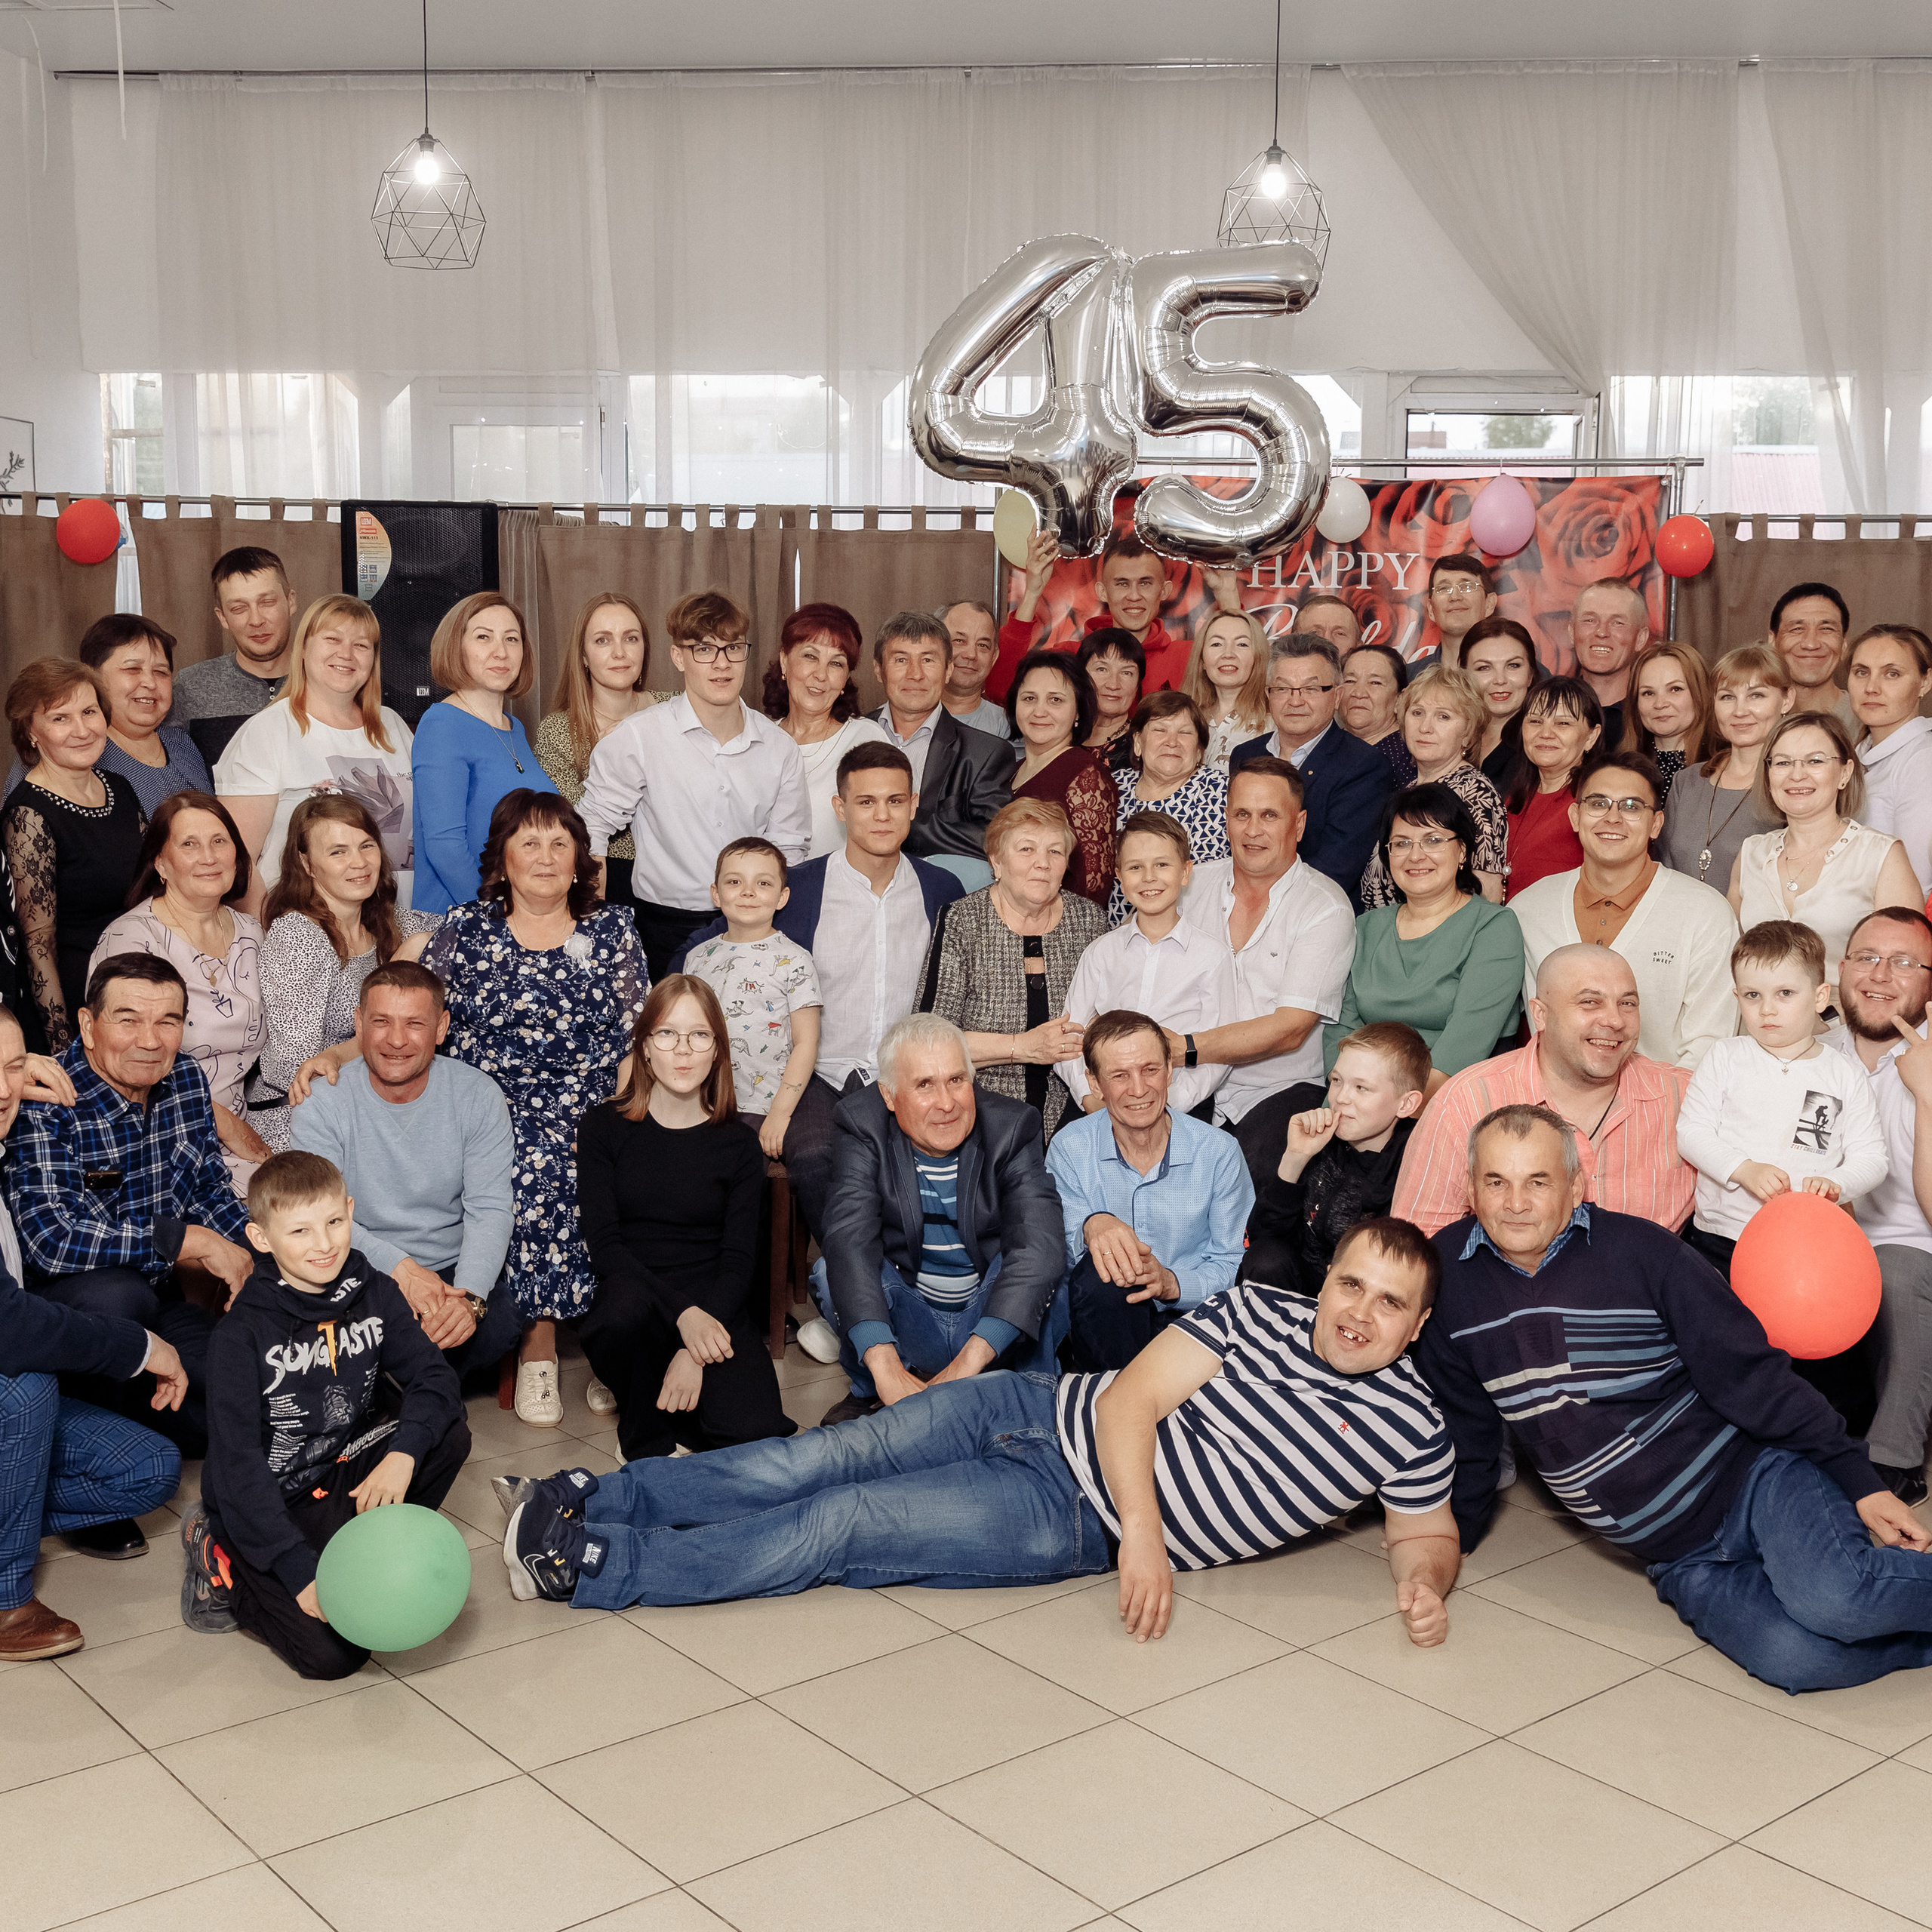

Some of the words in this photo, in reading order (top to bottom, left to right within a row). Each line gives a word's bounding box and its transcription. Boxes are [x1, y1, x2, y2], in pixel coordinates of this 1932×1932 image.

[908, 232, 1331, 570] 45
[1247, 550, 1420, 590] HAPPY
[1653, 951, 1675, 959] BITTER
[574, 1472, 589, 1484] NIKE
[589, 1546, 601, 1564] NIKE
